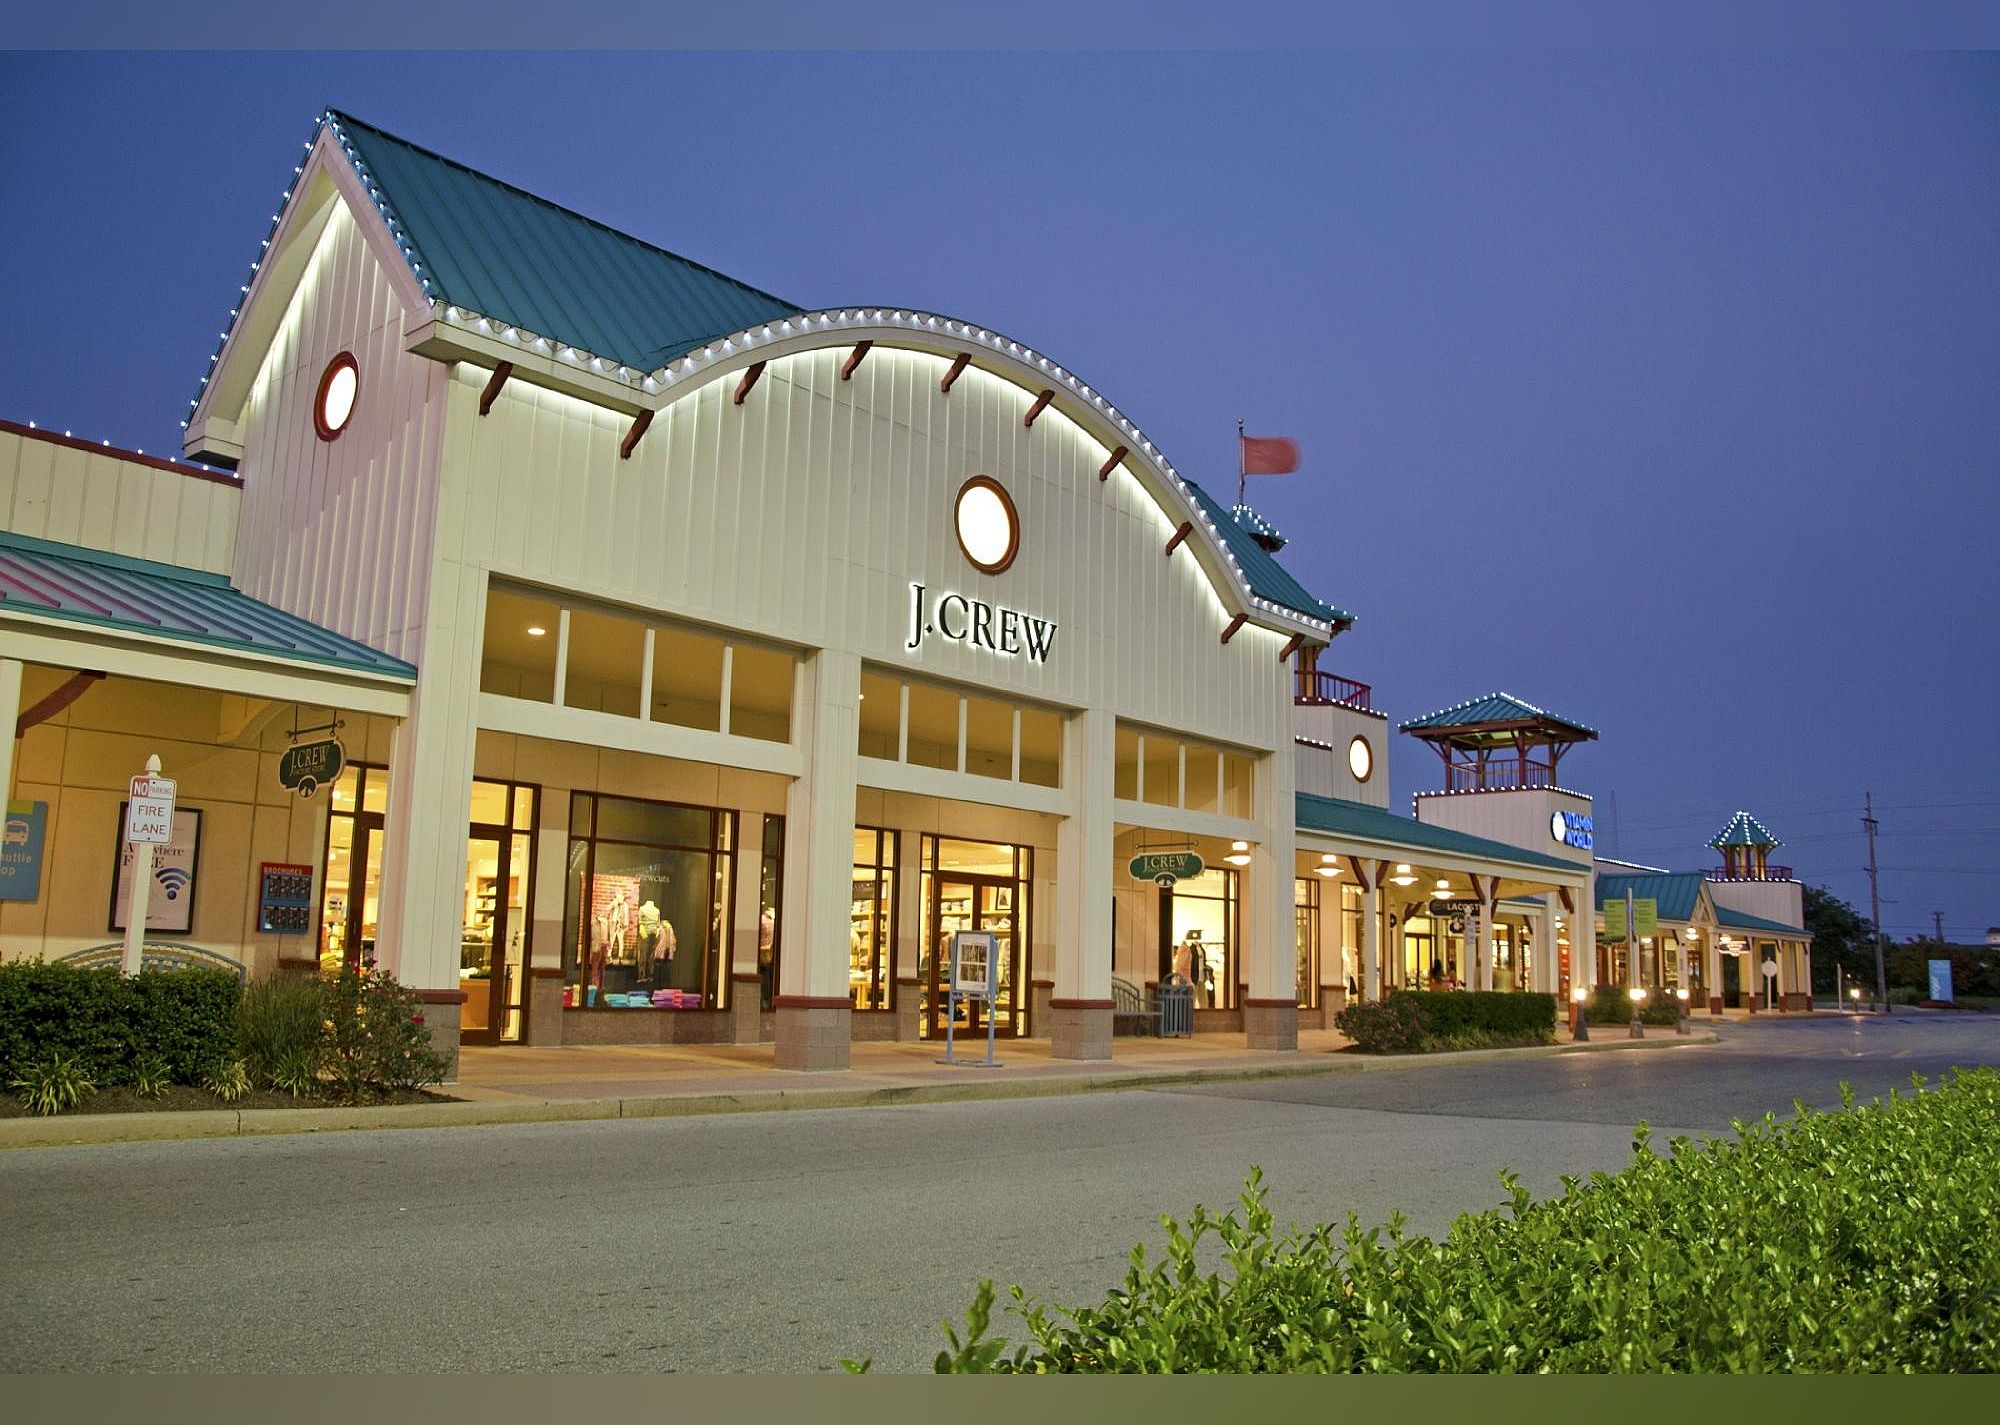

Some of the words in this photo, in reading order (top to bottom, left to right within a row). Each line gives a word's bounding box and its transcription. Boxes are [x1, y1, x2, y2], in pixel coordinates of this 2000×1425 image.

[908, 584, 1057, 663] J.CREW
[290, 745, 330, 778] J.CREW
[133, 782, 148, 796] NO
[138, 804, 165, 817] FIRE
[133, 822, 167, 835] LANE
[1565, 829, 1593, 850] WORLD
[1143, 854, 1188, 873] J.CREW
